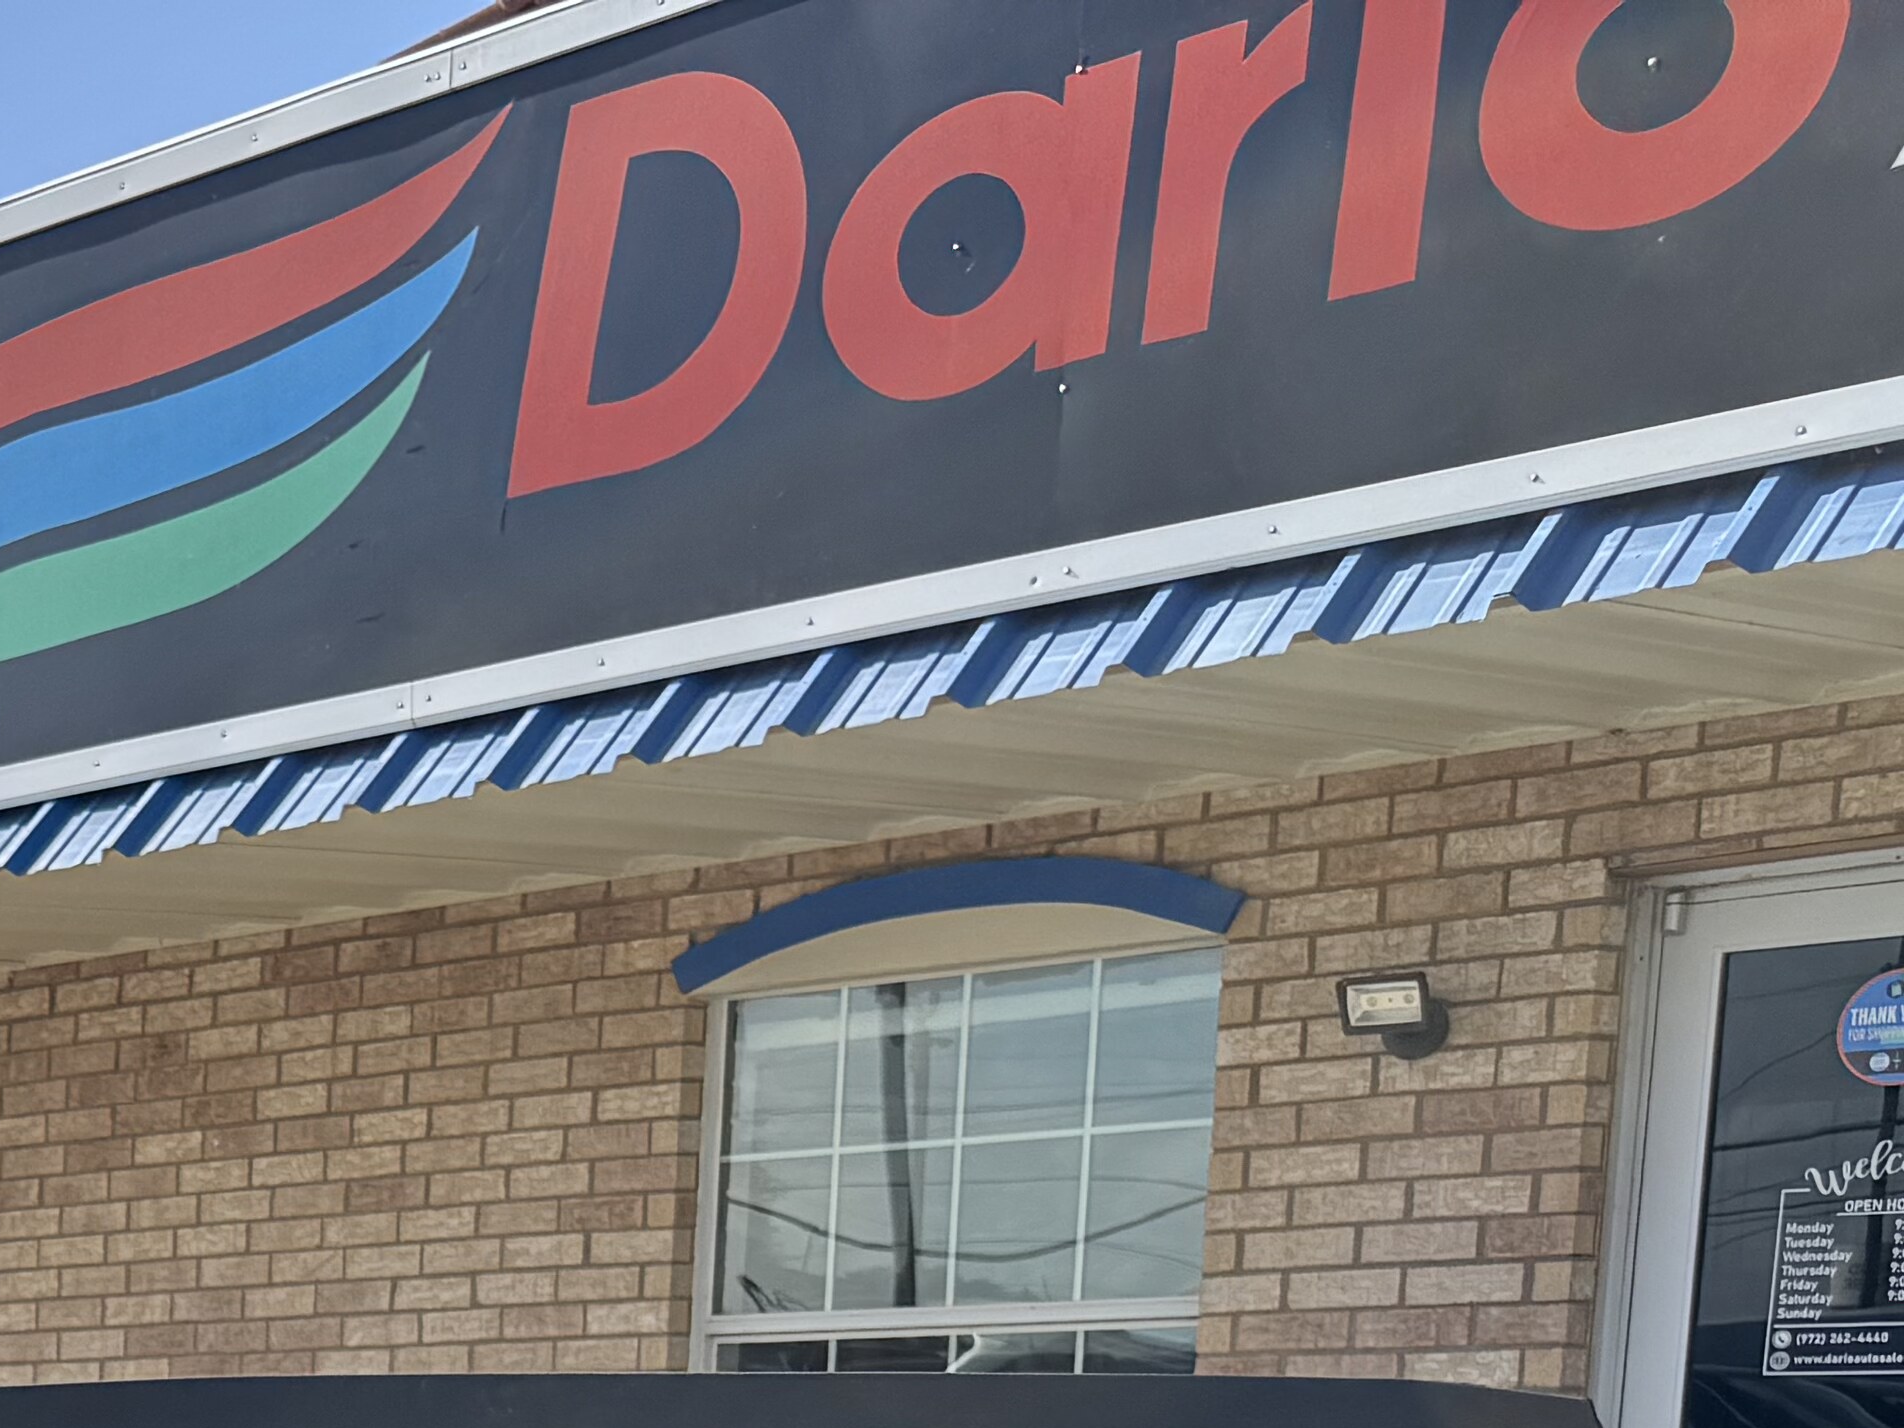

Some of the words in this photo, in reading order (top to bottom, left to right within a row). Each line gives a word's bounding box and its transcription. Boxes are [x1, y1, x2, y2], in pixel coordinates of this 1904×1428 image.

[505, 0, 1850, 499] Dario
[1850, 1005, 1897, 1026] THANK
[1804, 1139, 1904, 1196] Welc
[1844, 1199, 1884, 1213] OPEN
[1786, 1222, 1834, 1235] Monday
[1784, 1236, 1835, 1250] Tuesday
[1782, 1250, 1853, 1263] Wednesday
[1781, 1264, 1838, 1278] Thursday
[1779, 1278, 1819, 1292] Friday
[1778, 1292, 1834, 1306] Saturday
[1776, 1306, 1823, 1321] Sunday
[1796, 1332, 1827, 1346] (972)
